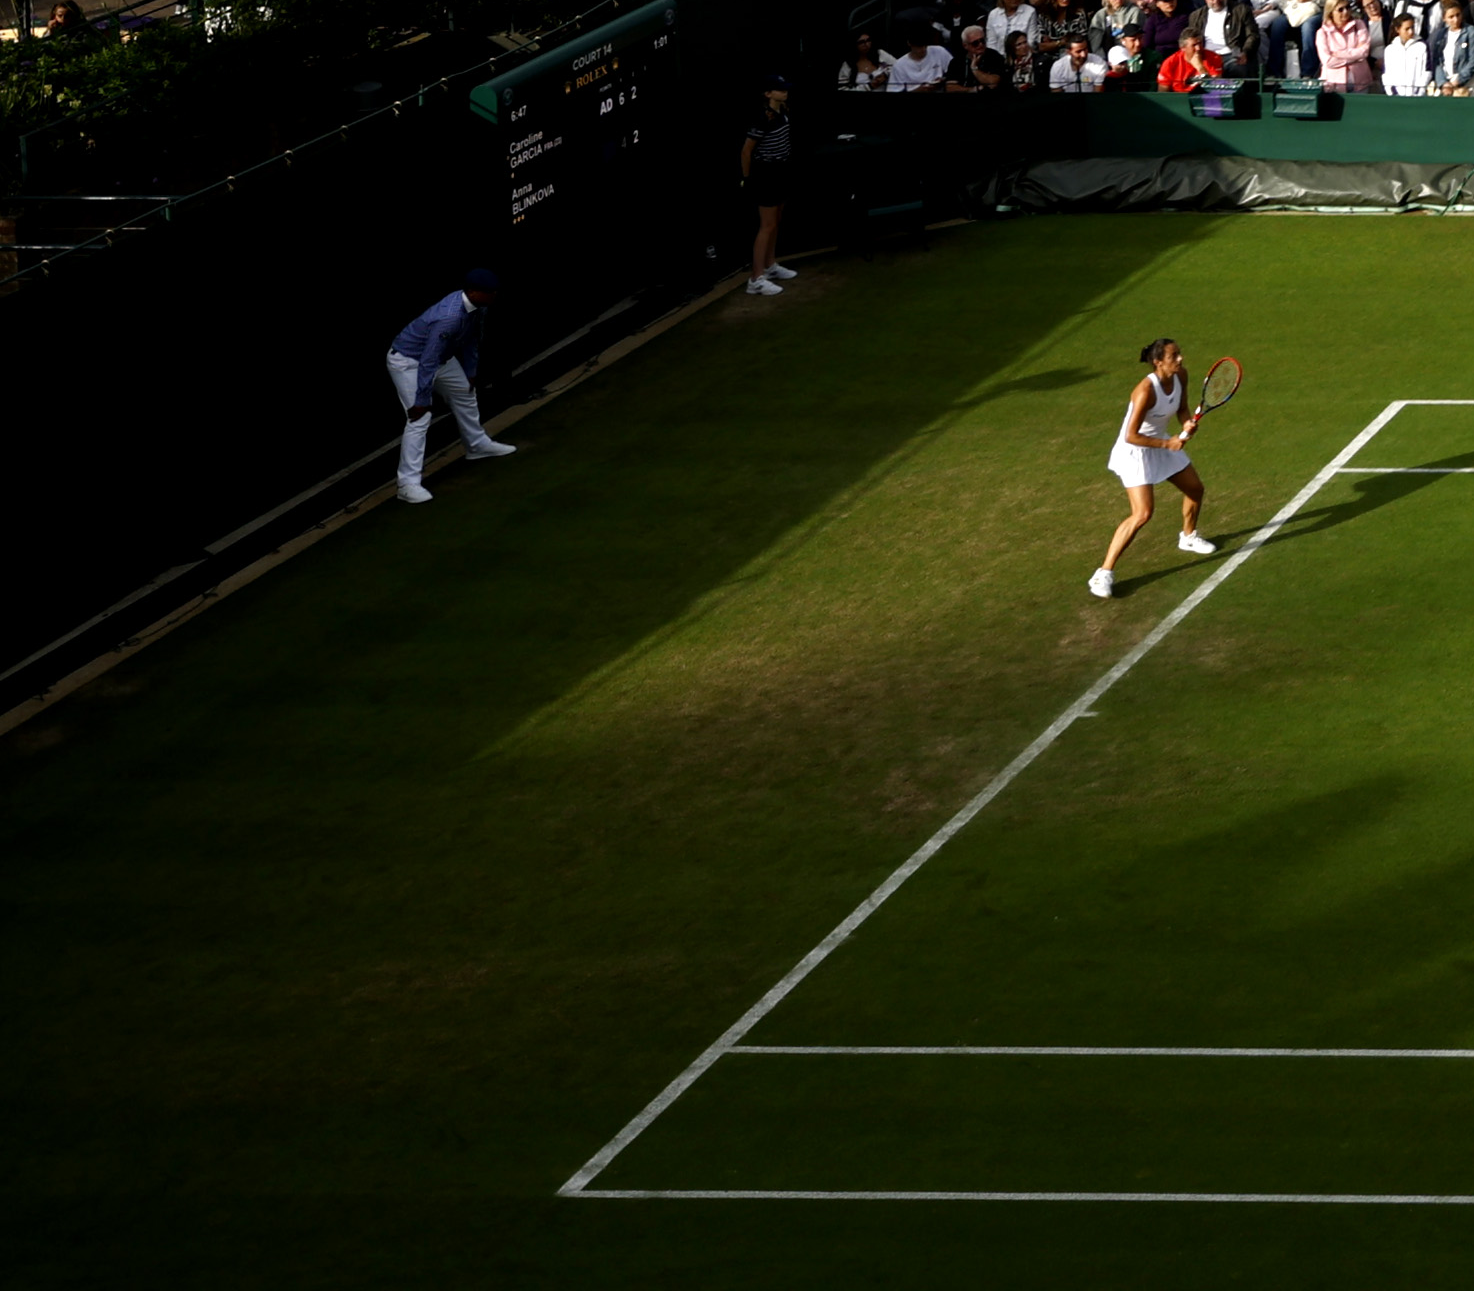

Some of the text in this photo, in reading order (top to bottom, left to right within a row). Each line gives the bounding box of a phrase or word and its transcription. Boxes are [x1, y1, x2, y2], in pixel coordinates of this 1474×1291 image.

[653, 35, 668, 50] 1:01
[572, 43, 612, 71] COURT 14
[576, 64, 608, 89] ROLEX
[510, 104, 527, 122] 6:47
[600, 85, 637, 116] AD 6 2
[509, 130, 543, 155] Caroline
[633, 129, 639, 144] 2
[510, 143, 543, 169] GARCIA
[512, 182, 533, 201] Anna
[512, 184, 555, 215] BLINKOVA
